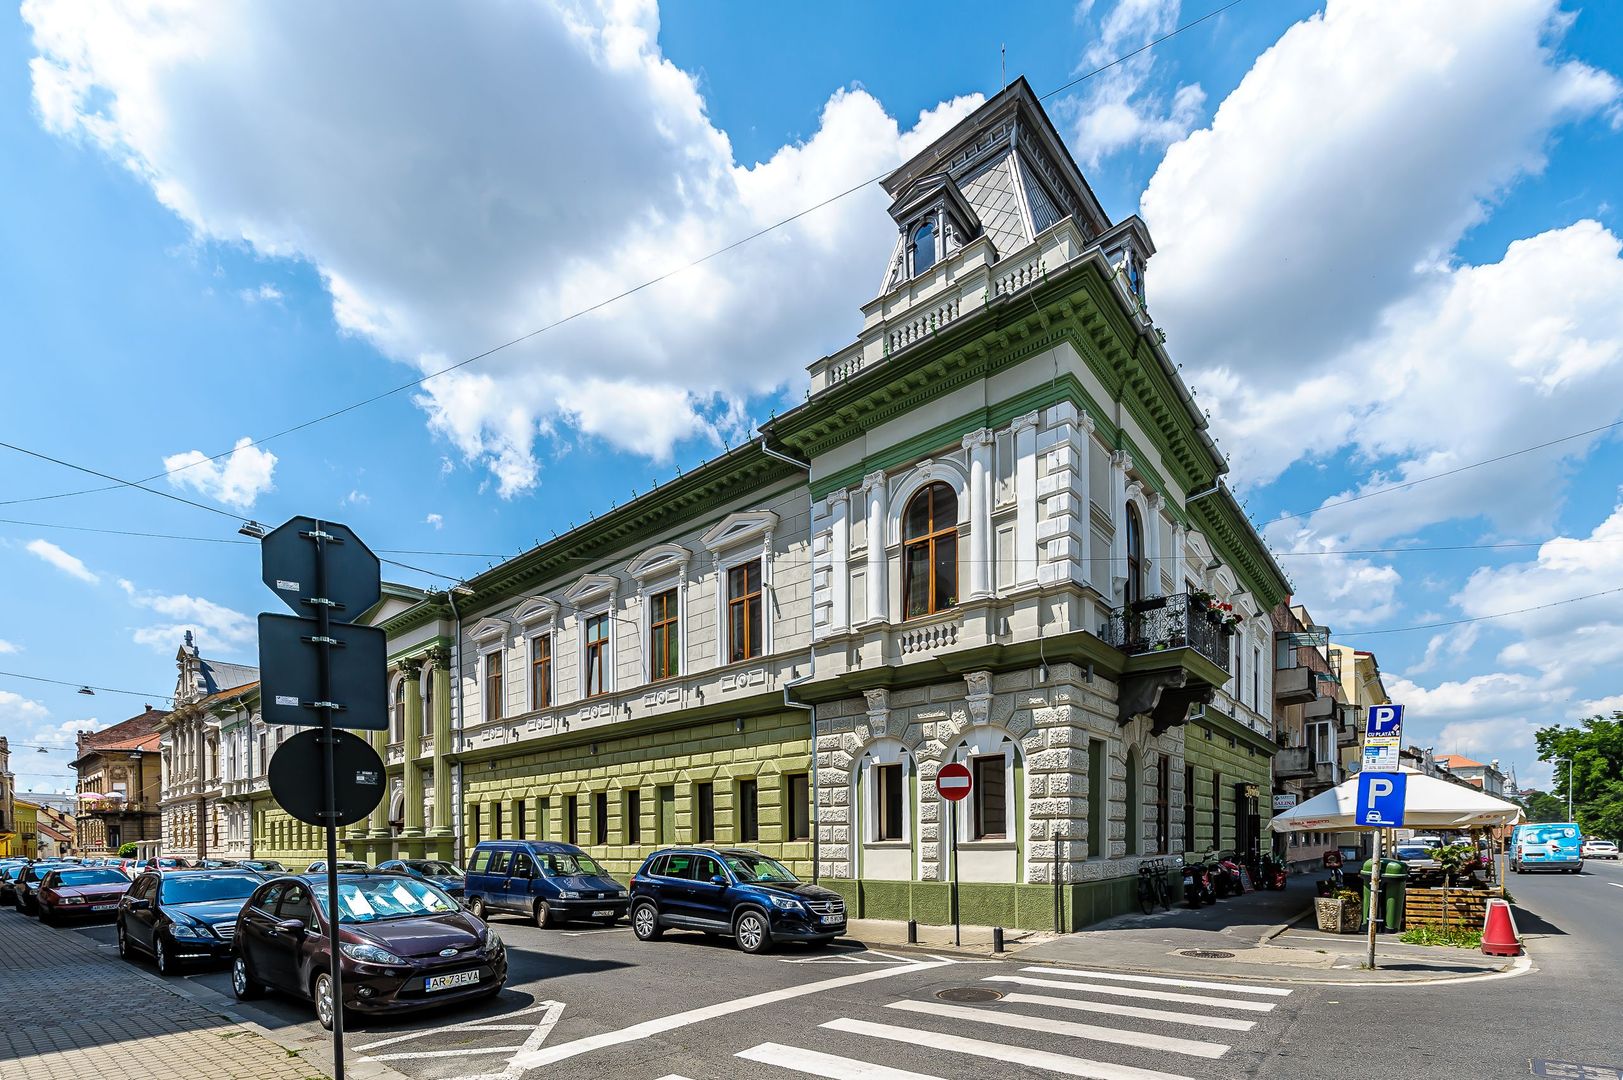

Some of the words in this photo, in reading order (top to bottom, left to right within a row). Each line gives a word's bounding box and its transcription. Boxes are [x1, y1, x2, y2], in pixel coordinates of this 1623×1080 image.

[1375, 707, 1395, 731] P
[1368, 778, 1394, 809] P
[431, 977, 446, 988] AR
